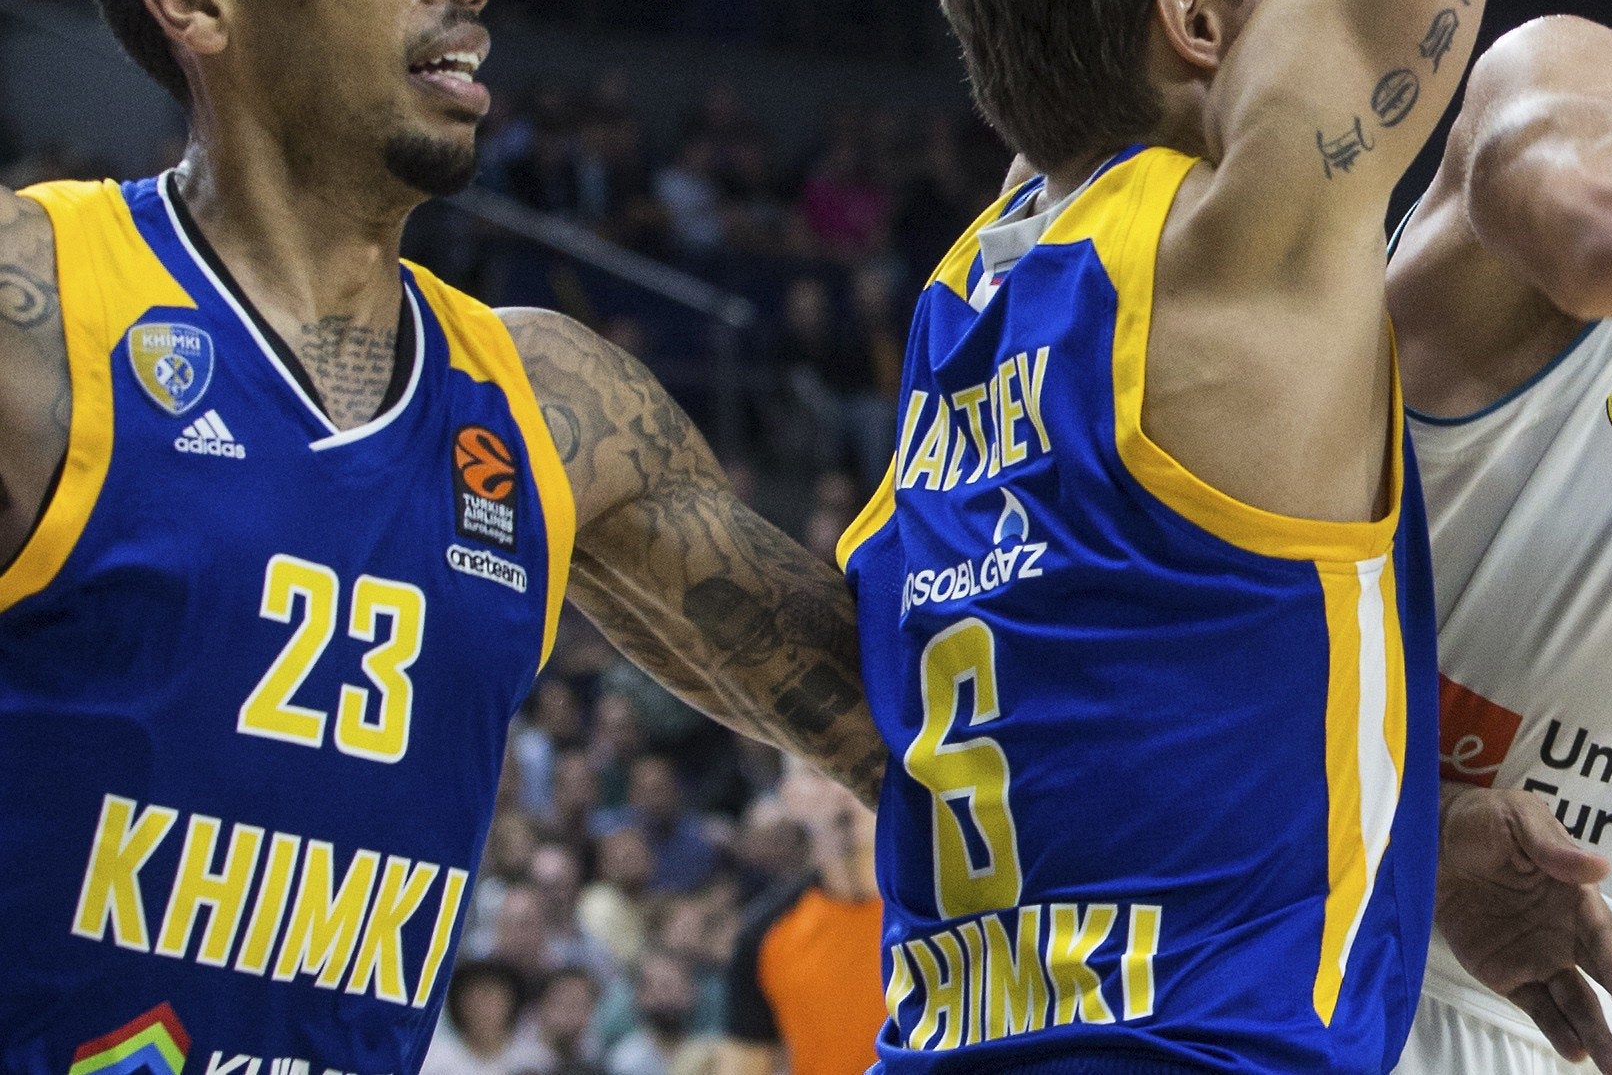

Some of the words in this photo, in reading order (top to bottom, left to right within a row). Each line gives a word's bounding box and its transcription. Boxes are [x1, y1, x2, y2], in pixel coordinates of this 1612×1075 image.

[174, 436, 246, 460] adidas
[450, 549, 526, 588] oneteam
[901, 542, 1048, 616] OSOBLGAZ
[237, 553, 427, 765] 23
[904, 616, 1023, 921] 6
[71, 793, 469, 1009] KHIMKI
